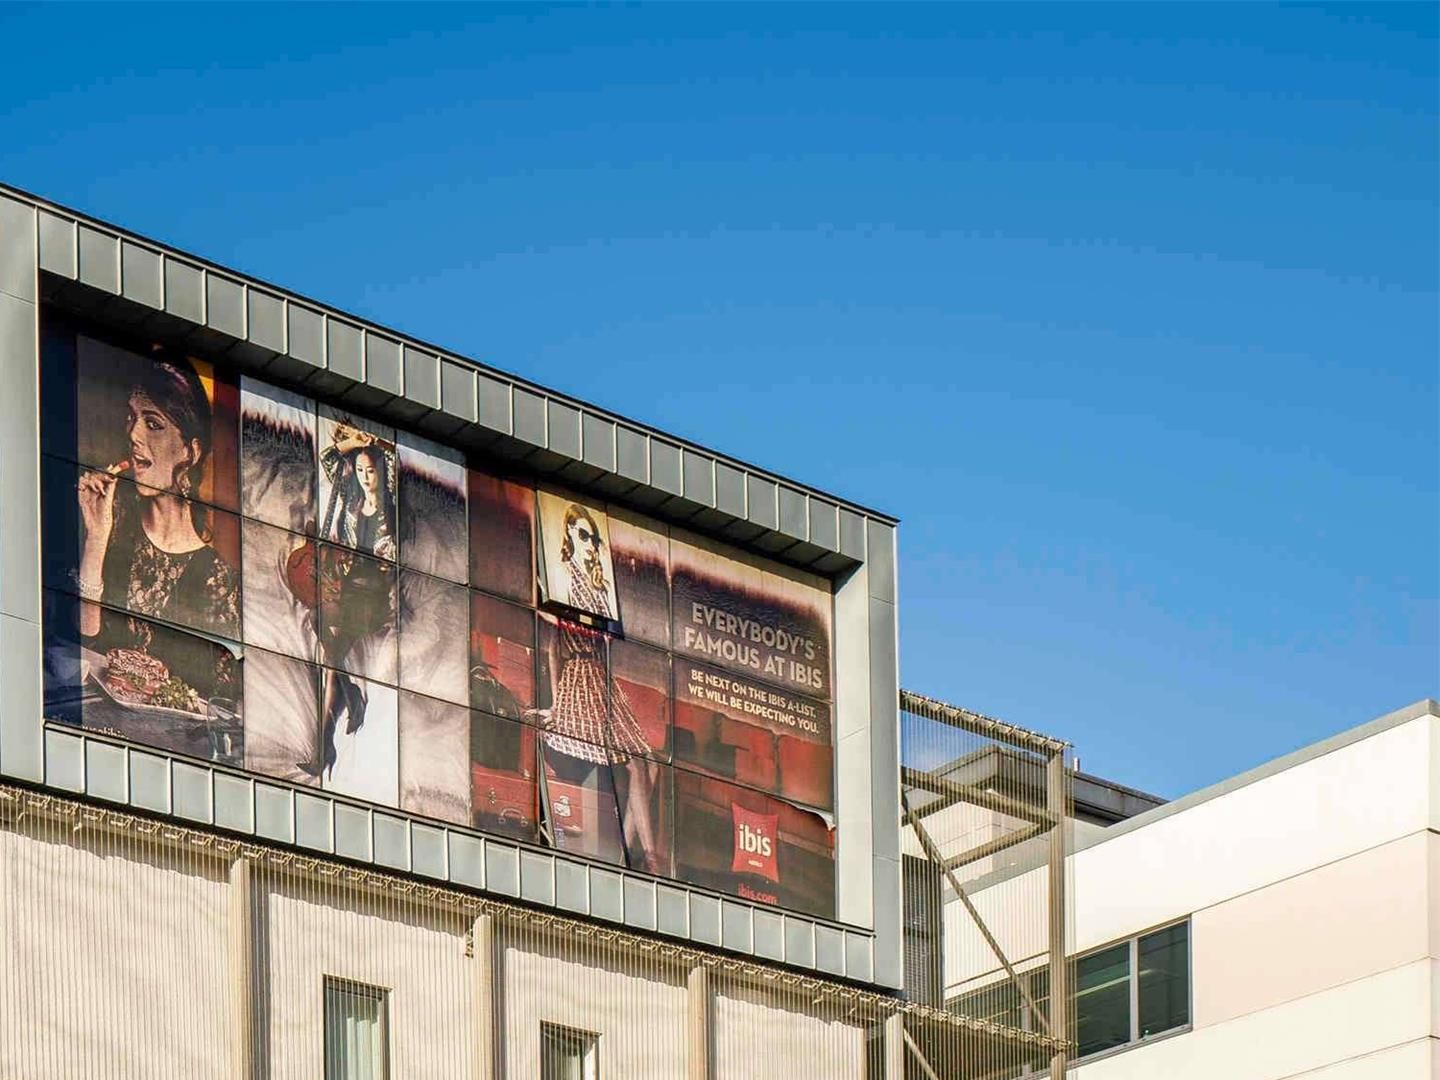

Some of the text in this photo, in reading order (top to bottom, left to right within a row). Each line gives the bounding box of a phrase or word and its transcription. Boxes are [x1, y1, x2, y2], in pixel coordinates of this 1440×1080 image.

[692, 602, 816, 661] EVERYBODY'S
[684, 626, 824, 690] FAMOUS AT IBIS
[688, 683, 820, 735] WE WILL BE EXPECTING YOU.
[691, 669, 705, 684] BE
[705, 674, 731, 691] NEXT
[732, 682, 747, 696] ON
[749, 687, 768, 704] THE
[769, 693, 786, 710] IBIS
[739, 823, 772, 857] ibis
